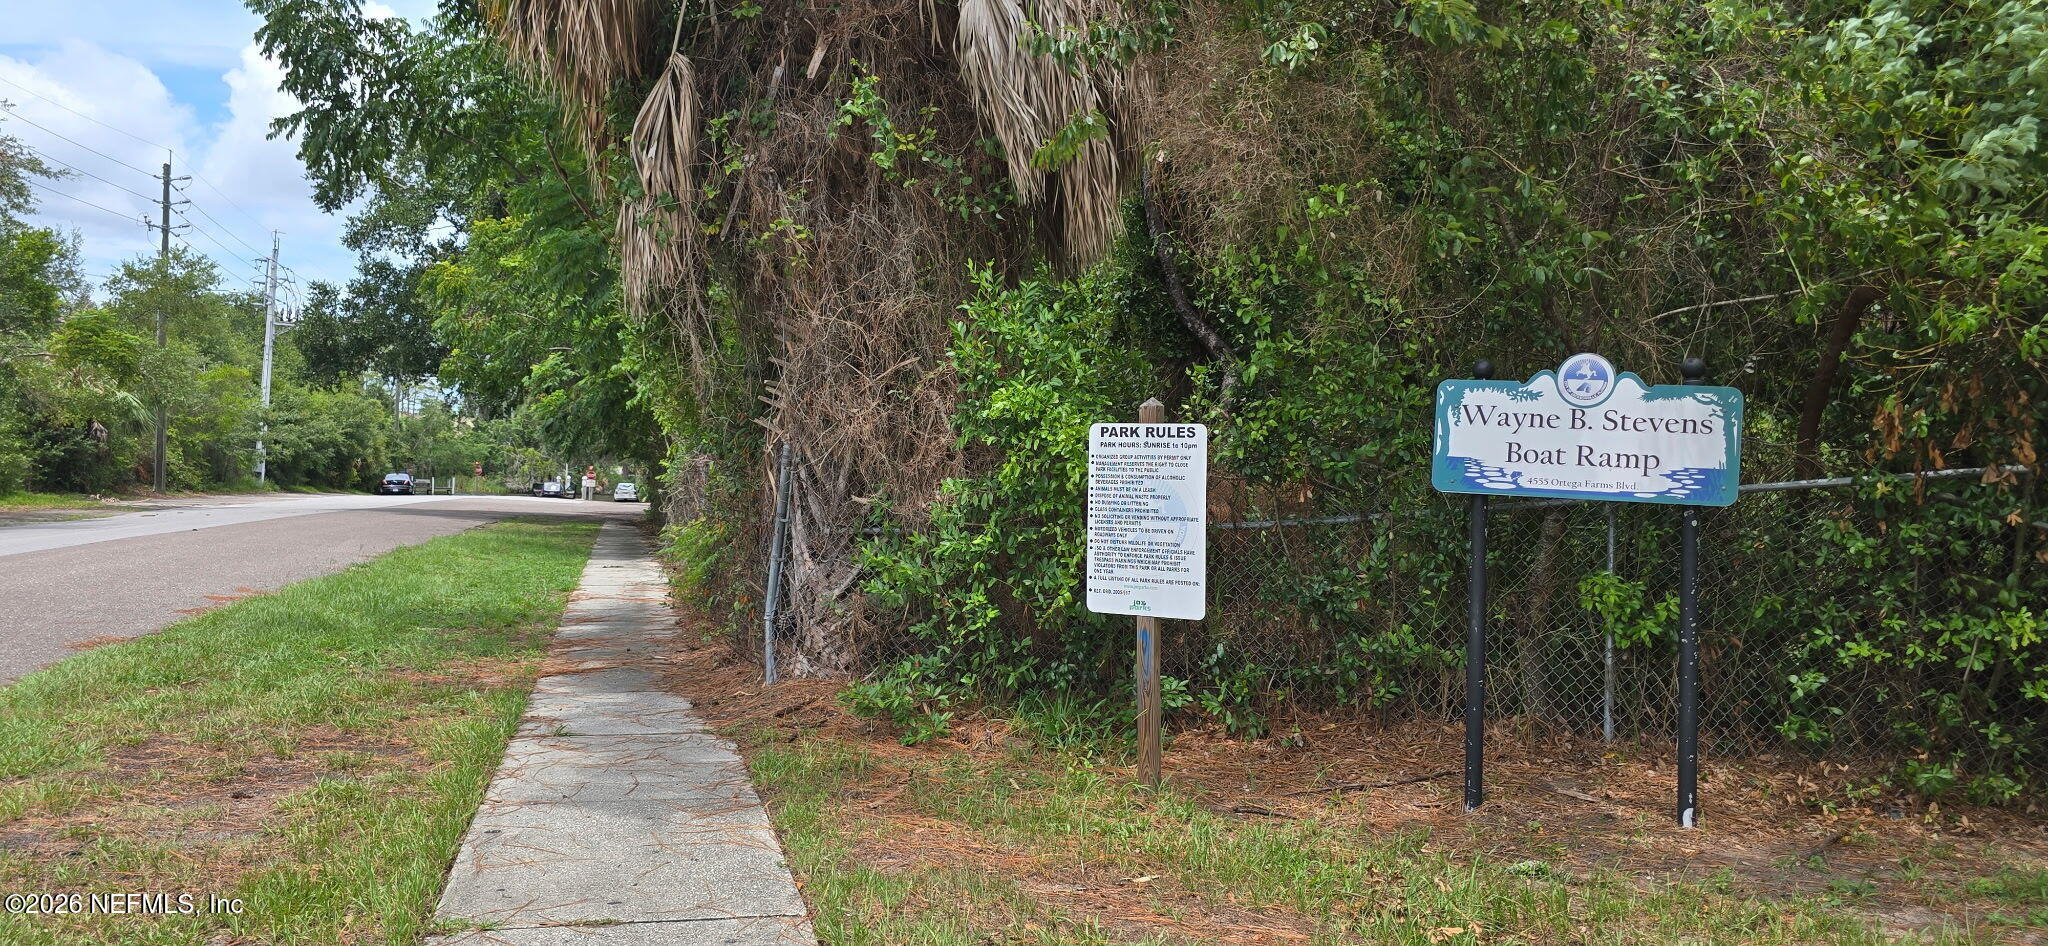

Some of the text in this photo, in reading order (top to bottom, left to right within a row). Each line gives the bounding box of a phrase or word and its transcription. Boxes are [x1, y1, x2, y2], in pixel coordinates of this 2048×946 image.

[1462, 404, 1714, 435] Wayne B. Stevens
[1100, 427, 1196, 438] PARK RULES
[1506, 442, 1660, 477] Boat Ramp
[1527, 477, 1639, 490] 4555 Ortega Farms Blvd.
